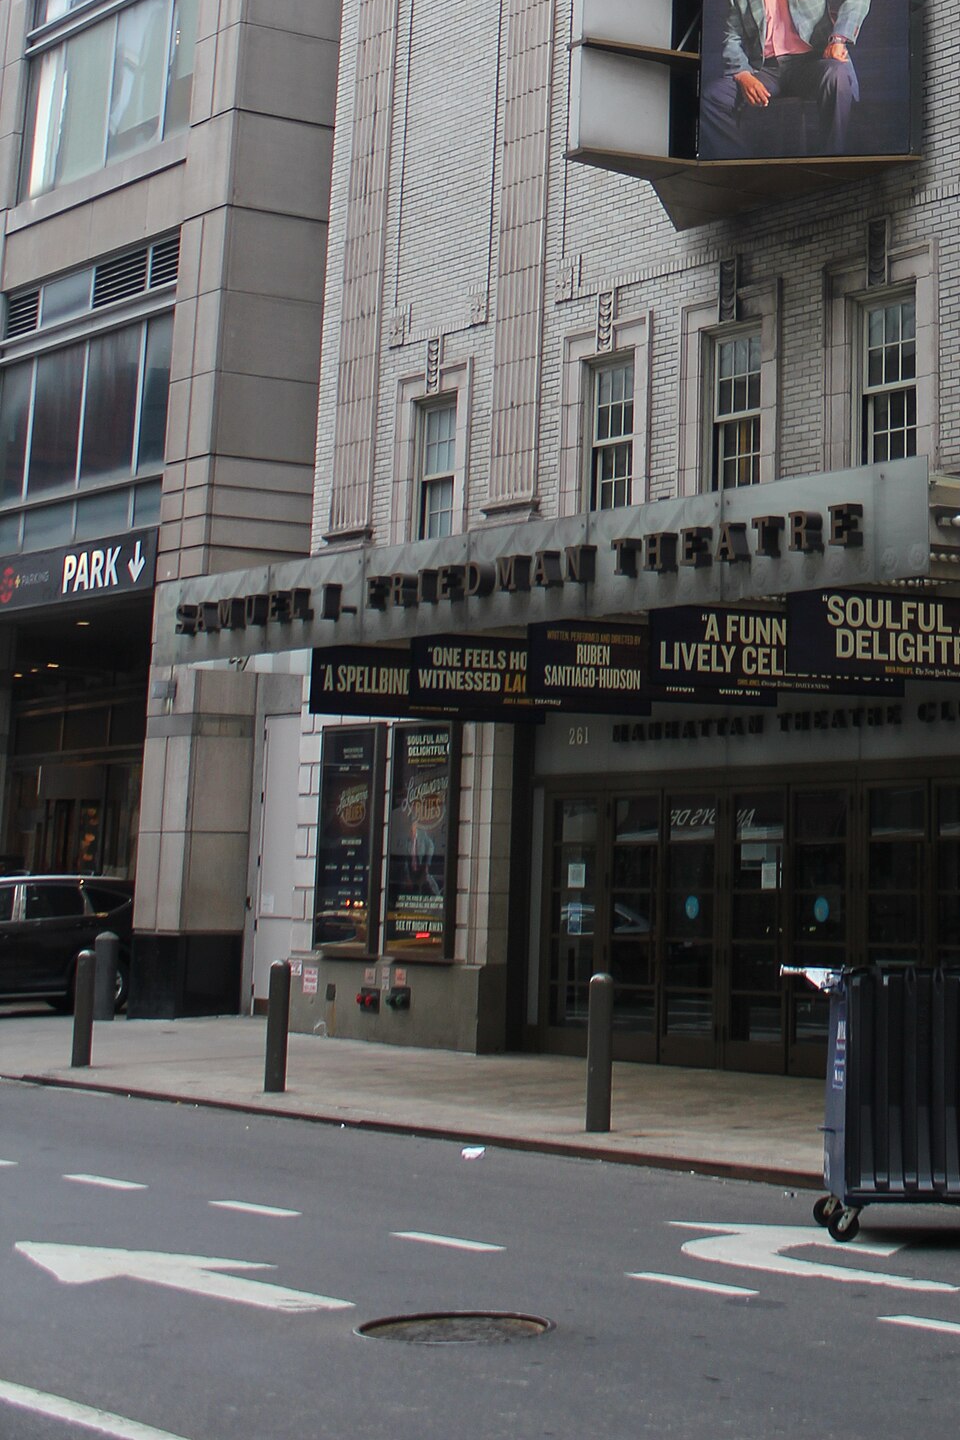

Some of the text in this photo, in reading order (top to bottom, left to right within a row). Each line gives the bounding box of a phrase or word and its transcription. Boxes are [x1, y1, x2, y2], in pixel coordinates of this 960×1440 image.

[62, 546, 122, 594] PARK
[176, 588, 315, 635] SAMUEL
[366, 545, 598, 611] FRIEDMAN
[611, 504, 864, 578] THEATRE
[465, 648, 507, 671] FEELS
[576, 643, 610, 666] RUBEN
[660, 640, 737, 673] LIVELY
[418, 669, 501, 692] WITNESSED
[544, 665, 641, 691] SANTIAGO-HUDSON
[569, 726, 590, 745] 261
[613, 715, 764, 742] MANHATTAN
[777, 705, 902, 731] THEATRE
[396, 920, 406, 931] SEE
